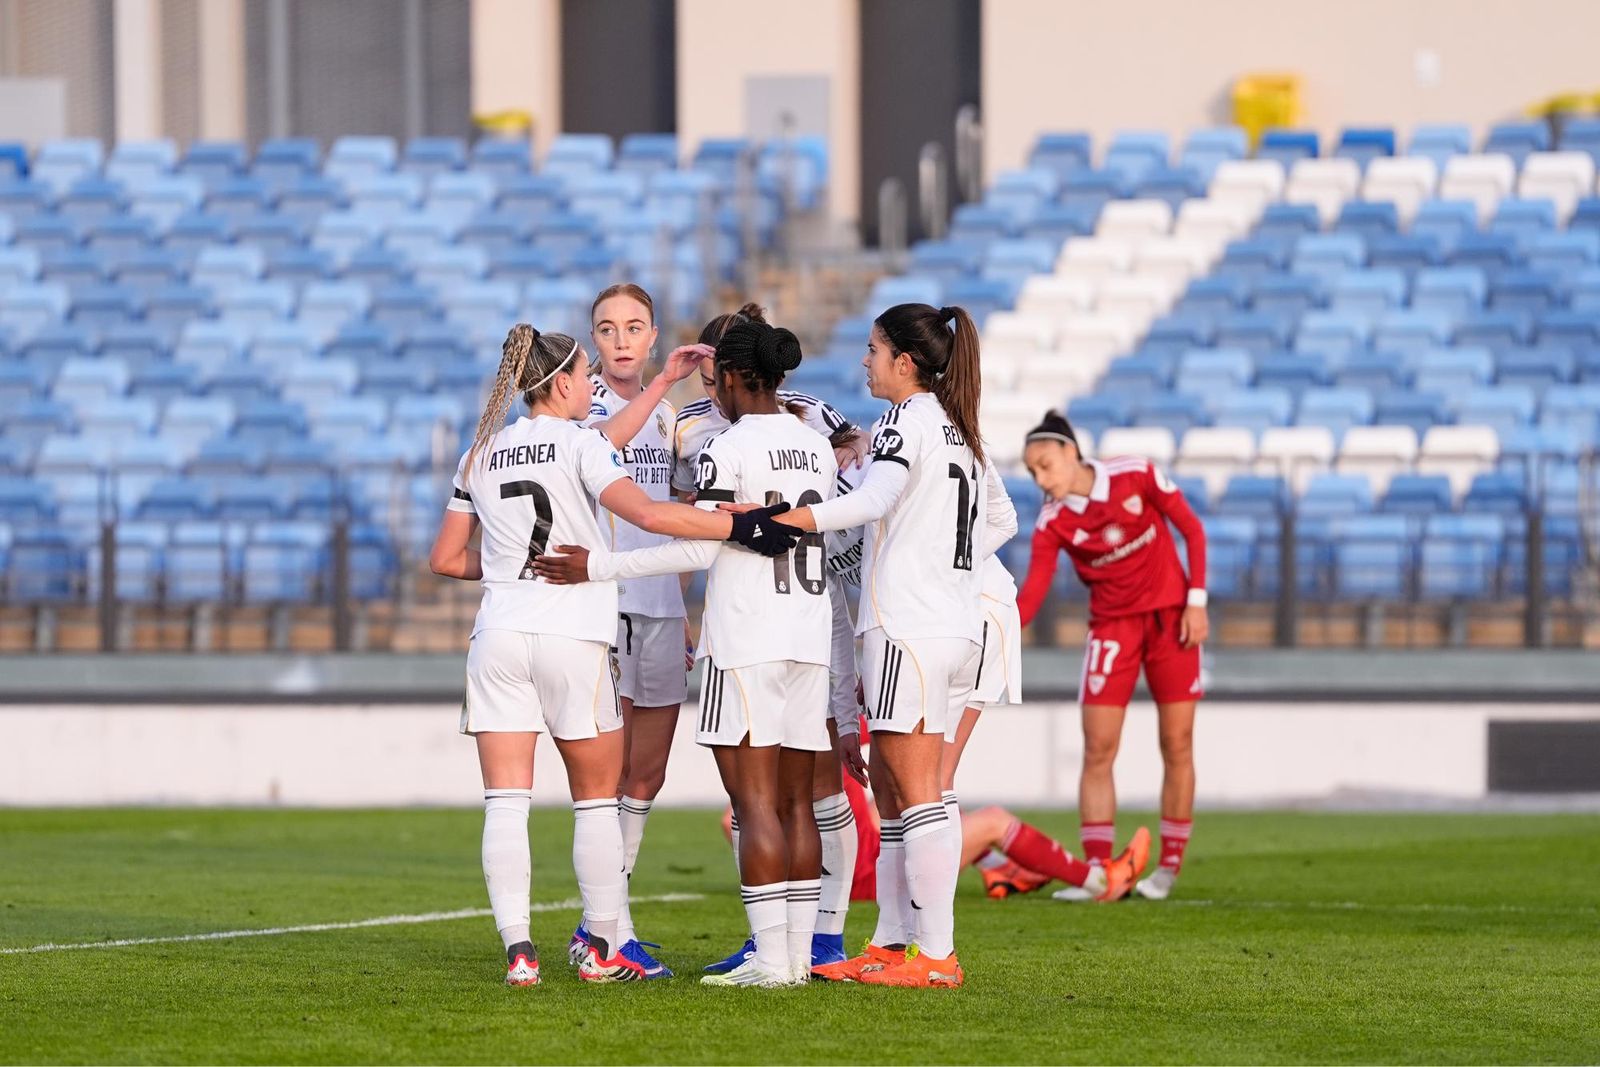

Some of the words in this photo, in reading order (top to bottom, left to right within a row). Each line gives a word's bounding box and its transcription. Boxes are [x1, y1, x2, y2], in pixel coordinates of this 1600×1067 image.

[488, 443, 556, 472] ATHENEA
[768, 449, 809, 471] LINDA
[811, 452, 822, 475] C.
[635, 467, 649, 484] FLY
[499, 479, 554, 580] 7
[1088, 638, 1121, 675] 17
